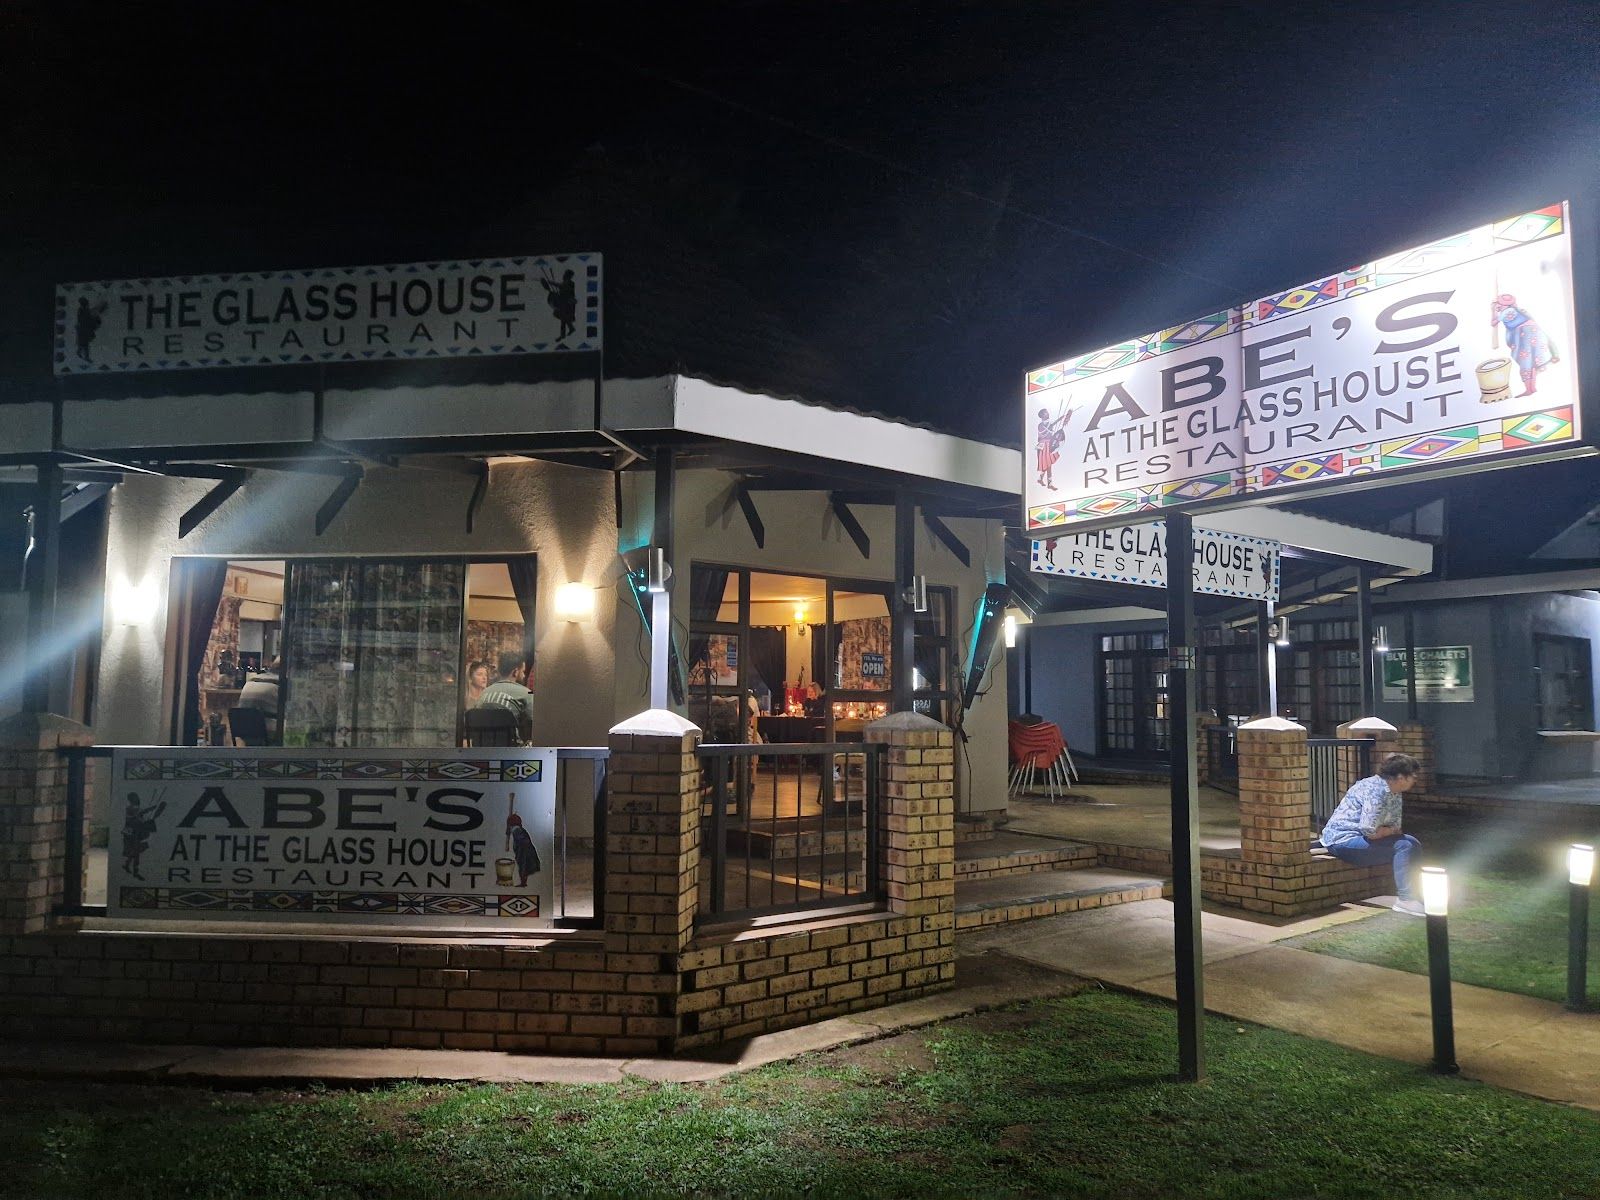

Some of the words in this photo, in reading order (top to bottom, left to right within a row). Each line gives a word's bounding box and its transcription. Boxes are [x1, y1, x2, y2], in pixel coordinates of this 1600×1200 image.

[120, 291, 201, 331] THE
[213, 283, 359, 326] GLASS
[369, 274, 526, 319] HOUSE
[122, 318, 520, 356] RESTAURANT
[1084, 289, 1459, 433] ABE'S
[1082, 425, 1115, 463] AT
[1120, 415, 1180, 455] THE
[1186, 387, 1303, 439] GLASS
[1312, 345, 1462, 412] HOUSE
[1083, 390, 1464, 489] RESTAURANT
[1072, 550, 1252, 588] RESTARANT
[1120, 526, 1167, 559] GLA
[1192, 539, 1254, 572] HOUSE
[863, 662, 884, 675] OPEN
[1421, 649, 1466, 660] CHALETS
[175, 786, 485, 832] ABE'S
[169, 834, 207, 862] AT
[215, 835, 270, 863] THE
[281, 836, 375, 865] GLASS
[387, 839, 486, 868] HOUSE
[168, 867, 486, 889] RESTAURANT
